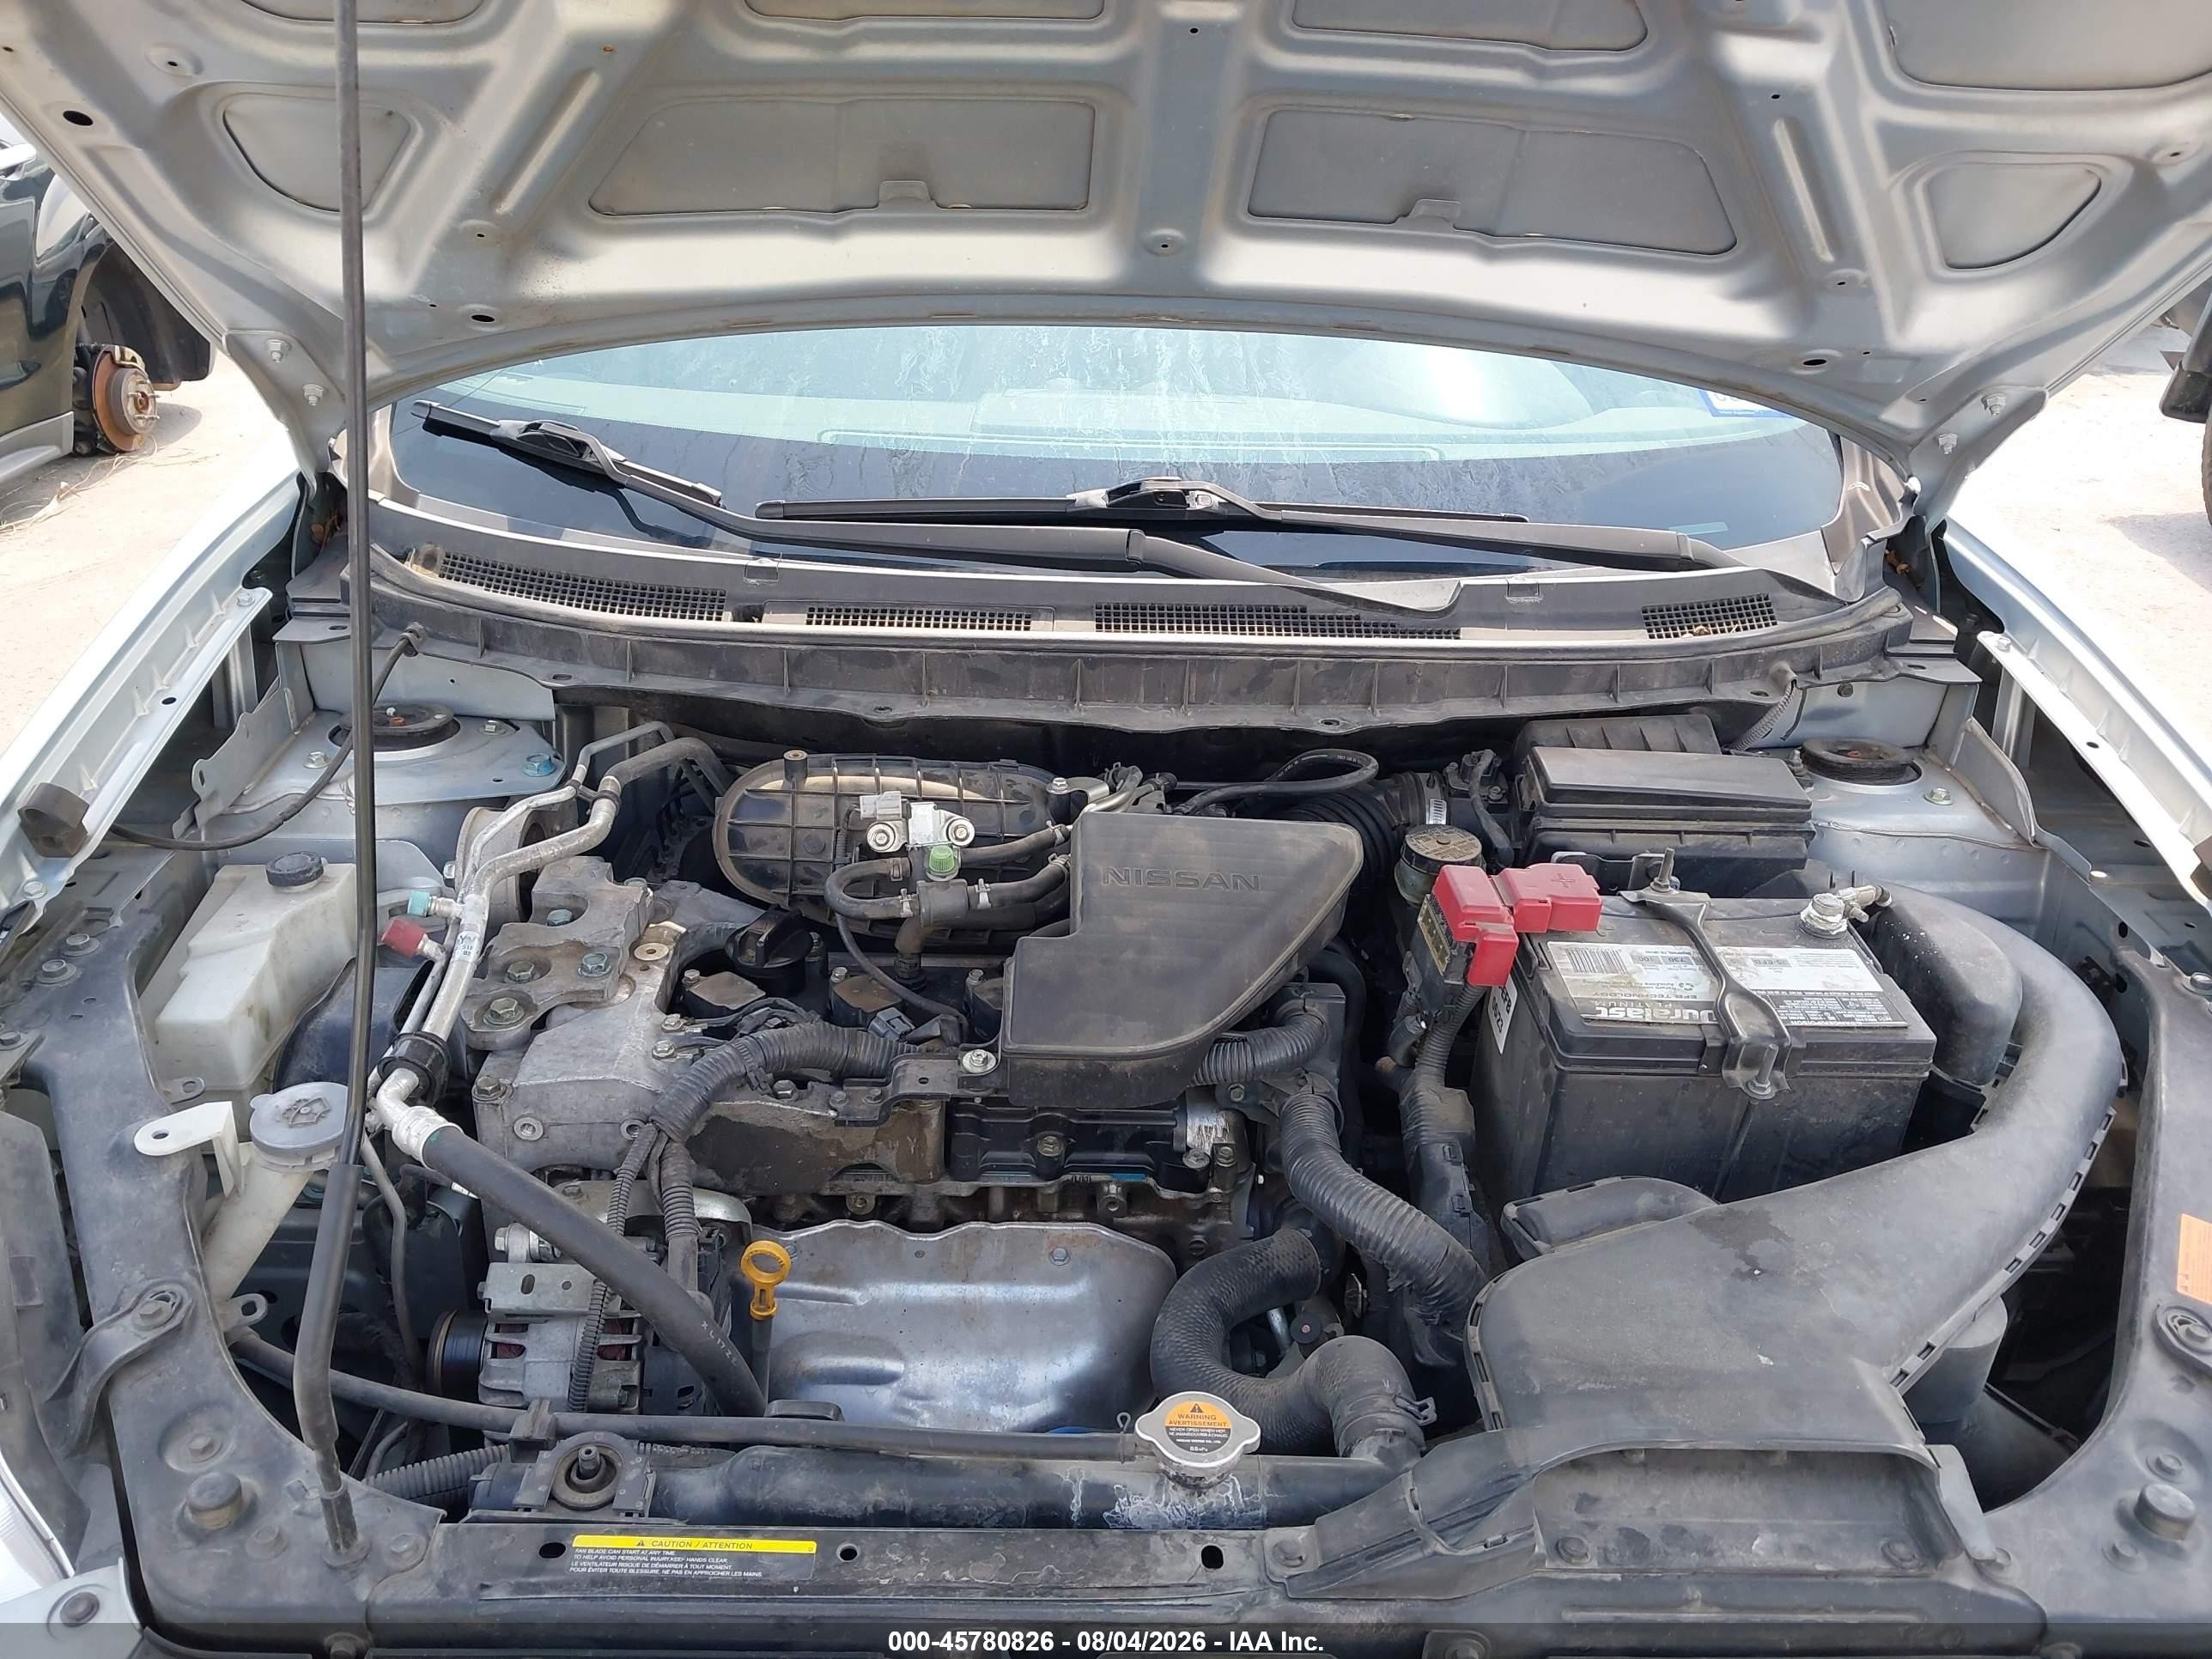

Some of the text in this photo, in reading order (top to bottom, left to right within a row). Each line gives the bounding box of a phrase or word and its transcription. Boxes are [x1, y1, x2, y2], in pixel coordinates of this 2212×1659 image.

[1101, 866, 1261, 892] NISSAN
[1593, 991, 1671, 1000] TECHNOLOGY
[1595, 1000, 1673, 1009] PLATINUM
